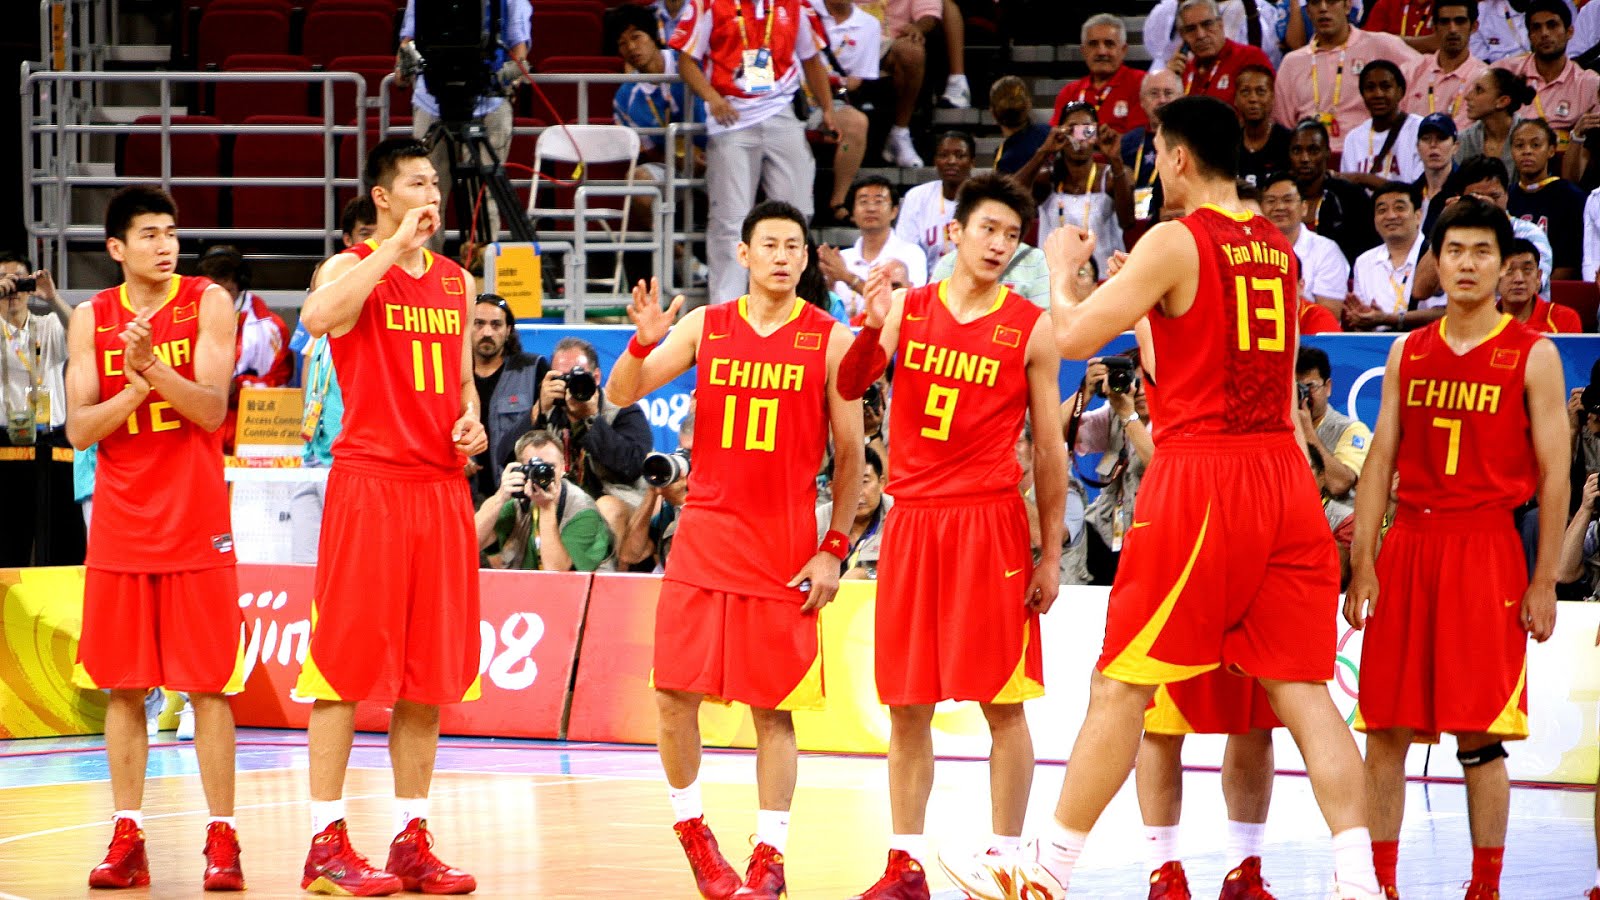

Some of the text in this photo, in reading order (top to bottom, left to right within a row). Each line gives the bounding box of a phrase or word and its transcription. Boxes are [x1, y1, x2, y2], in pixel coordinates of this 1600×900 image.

[1220, 240, 1289, 275] Yao Ming
[385, 303, 461, 335] CHINA
[1235, 275, 1286, 353] 13
[104, 337, 191, 376] CNA
[412, 339, 445, 394] 11
[709, 357, 805, 392] CHINA
[904, 339, 1001, 387] CHINA
[920, 382, 960, 442] 9
[1406, 379, 1501, 414] CHINA
[245, 416, 303, 424] Access Contro
[721, 394, 779, 452] 10
[1432, 417, 1462, 475] 7
